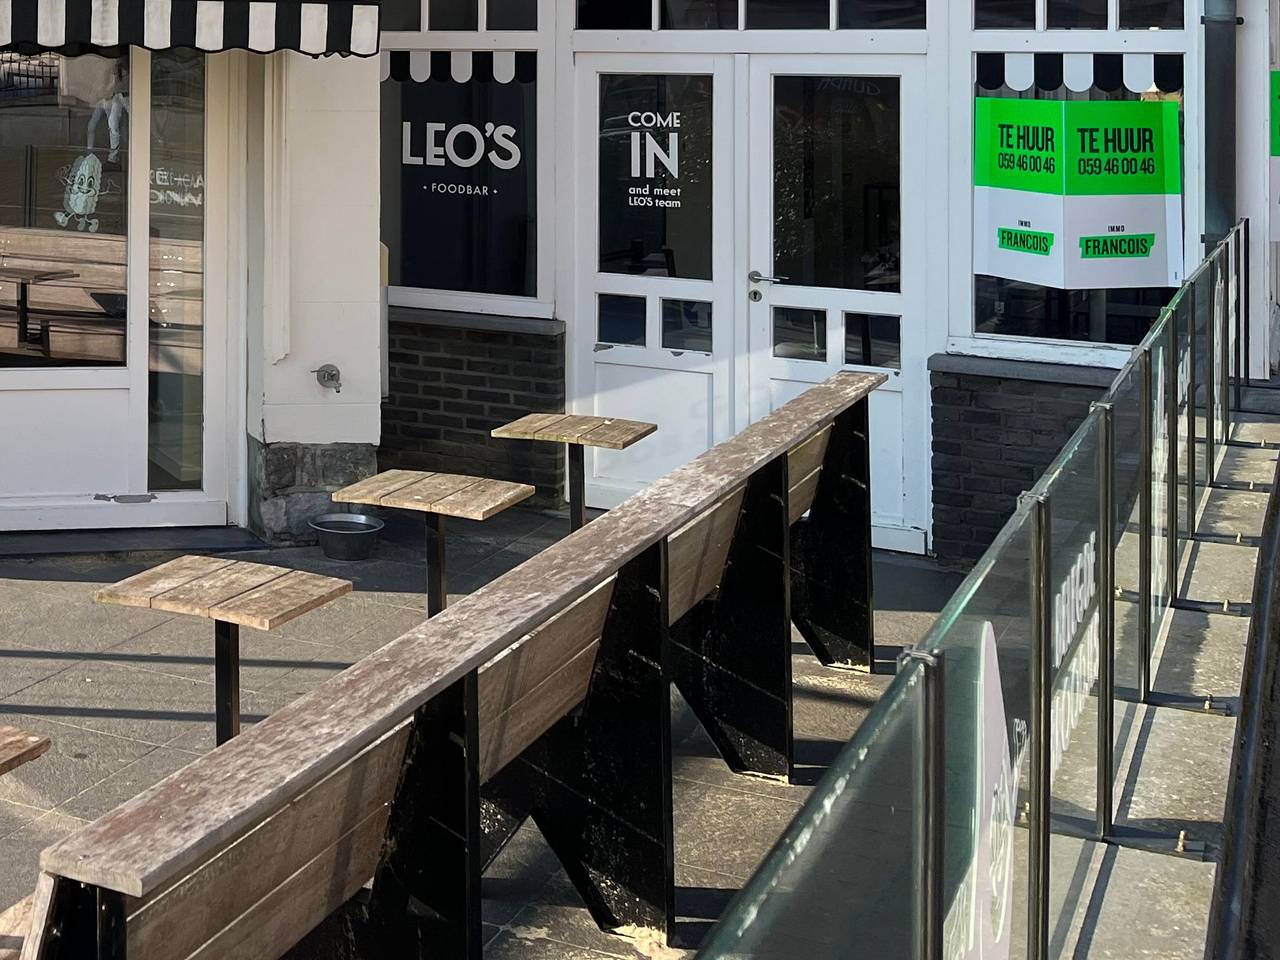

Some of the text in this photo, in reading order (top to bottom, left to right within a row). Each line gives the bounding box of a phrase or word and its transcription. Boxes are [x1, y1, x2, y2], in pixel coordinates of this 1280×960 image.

[628, 111, 681, 128] COME
[402, 121, 521, 170] LEO'S
[997, 123, 1055, 153] TE HUUR
[1077, 127, 1154, 153] TE HUUR
[631, 131, 679, 179] IN
[998, 152, 1055, 174] 059 46 00 46
[1078, 157, 1155, 175] 059 46 00 46
[431, 182, 490, 197] FOODBAR
[628, 184, 681, 197] and meet
[628, 196, 681, 208] LEO'S team
[1107, 225, 1125, 233] IMMO
[1001, 230, 1049, 253] FRANCOIS
[1085, 238, 1148, 256] FRANCOIS
